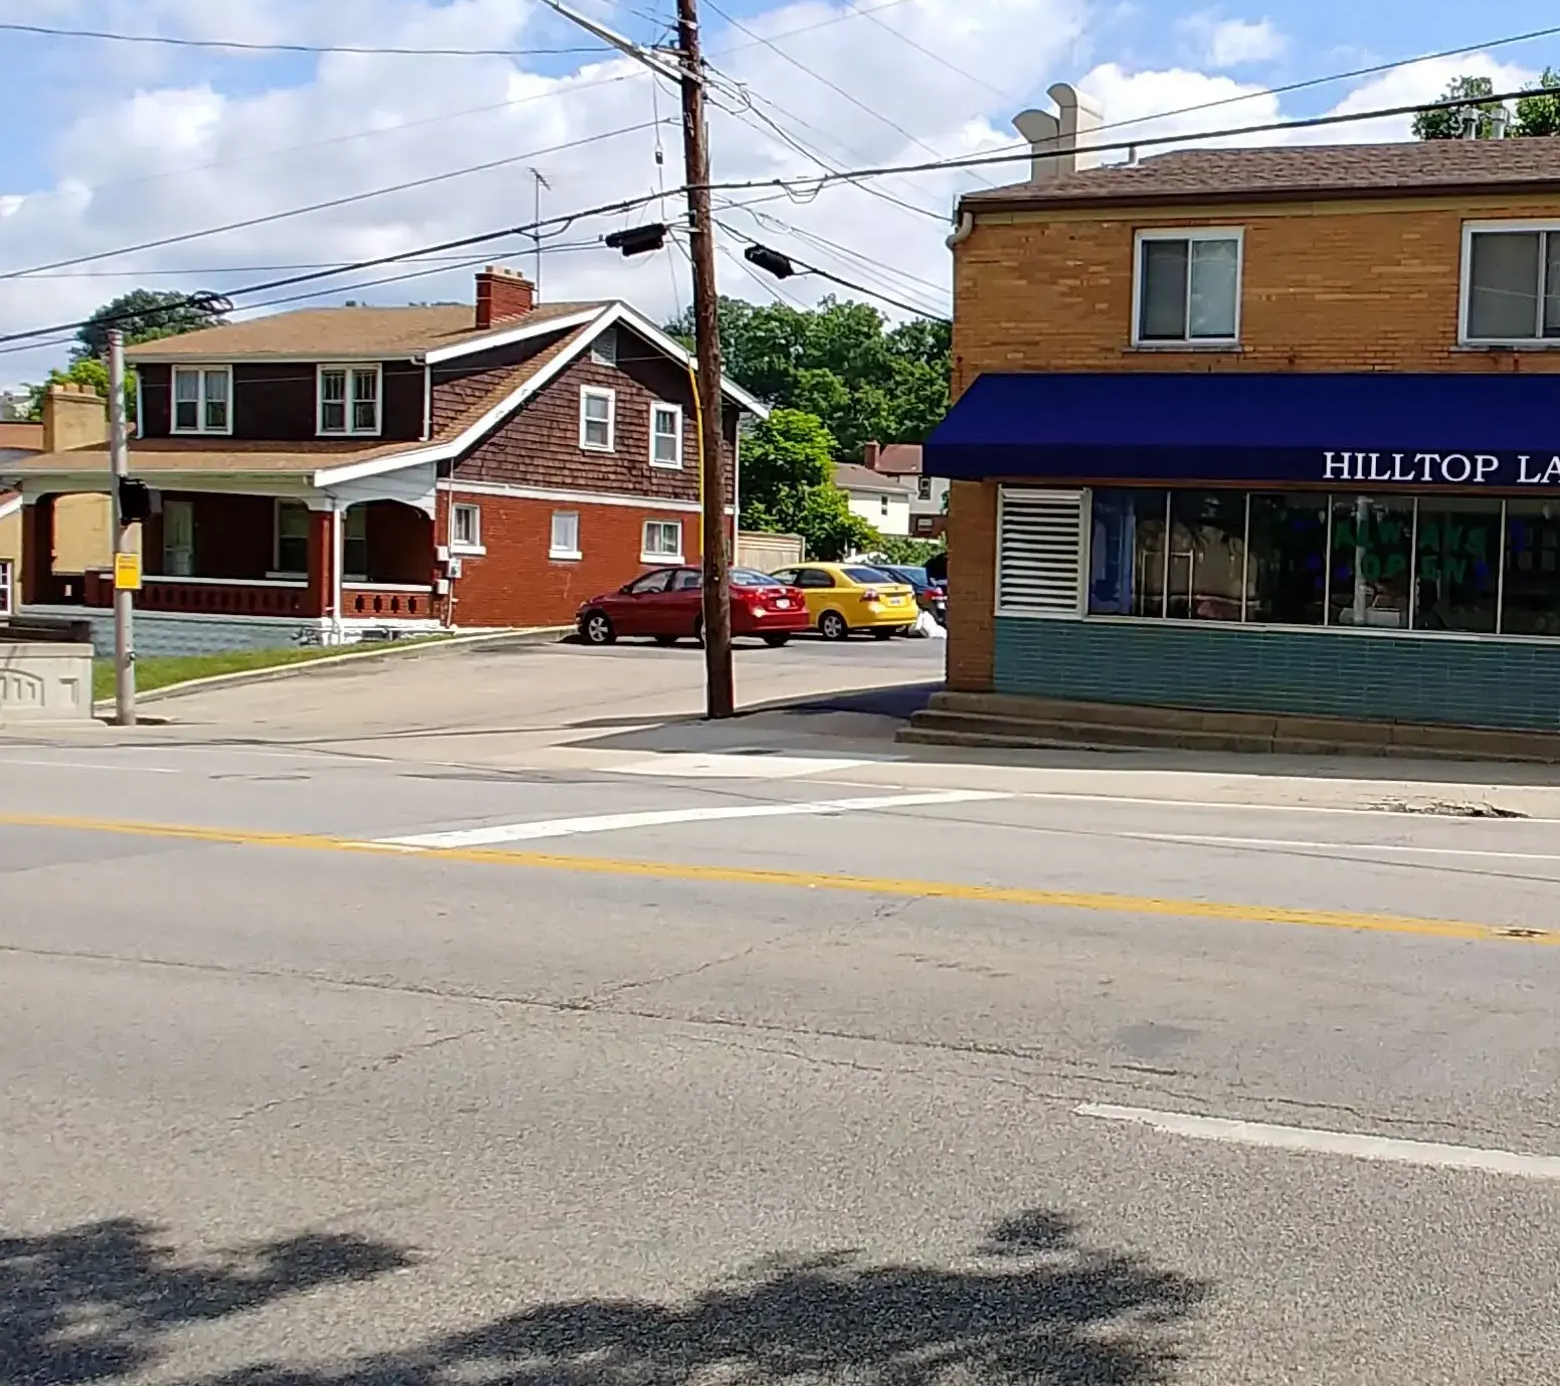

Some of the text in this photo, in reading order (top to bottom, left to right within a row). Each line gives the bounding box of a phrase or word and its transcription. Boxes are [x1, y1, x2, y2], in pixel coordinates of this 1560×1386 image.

[1322, 451, 1499, 481] HILLTOP
[1334, 519, 1489, 556] ALWAYS
[1361, 551, 1467, 584] OPEN
